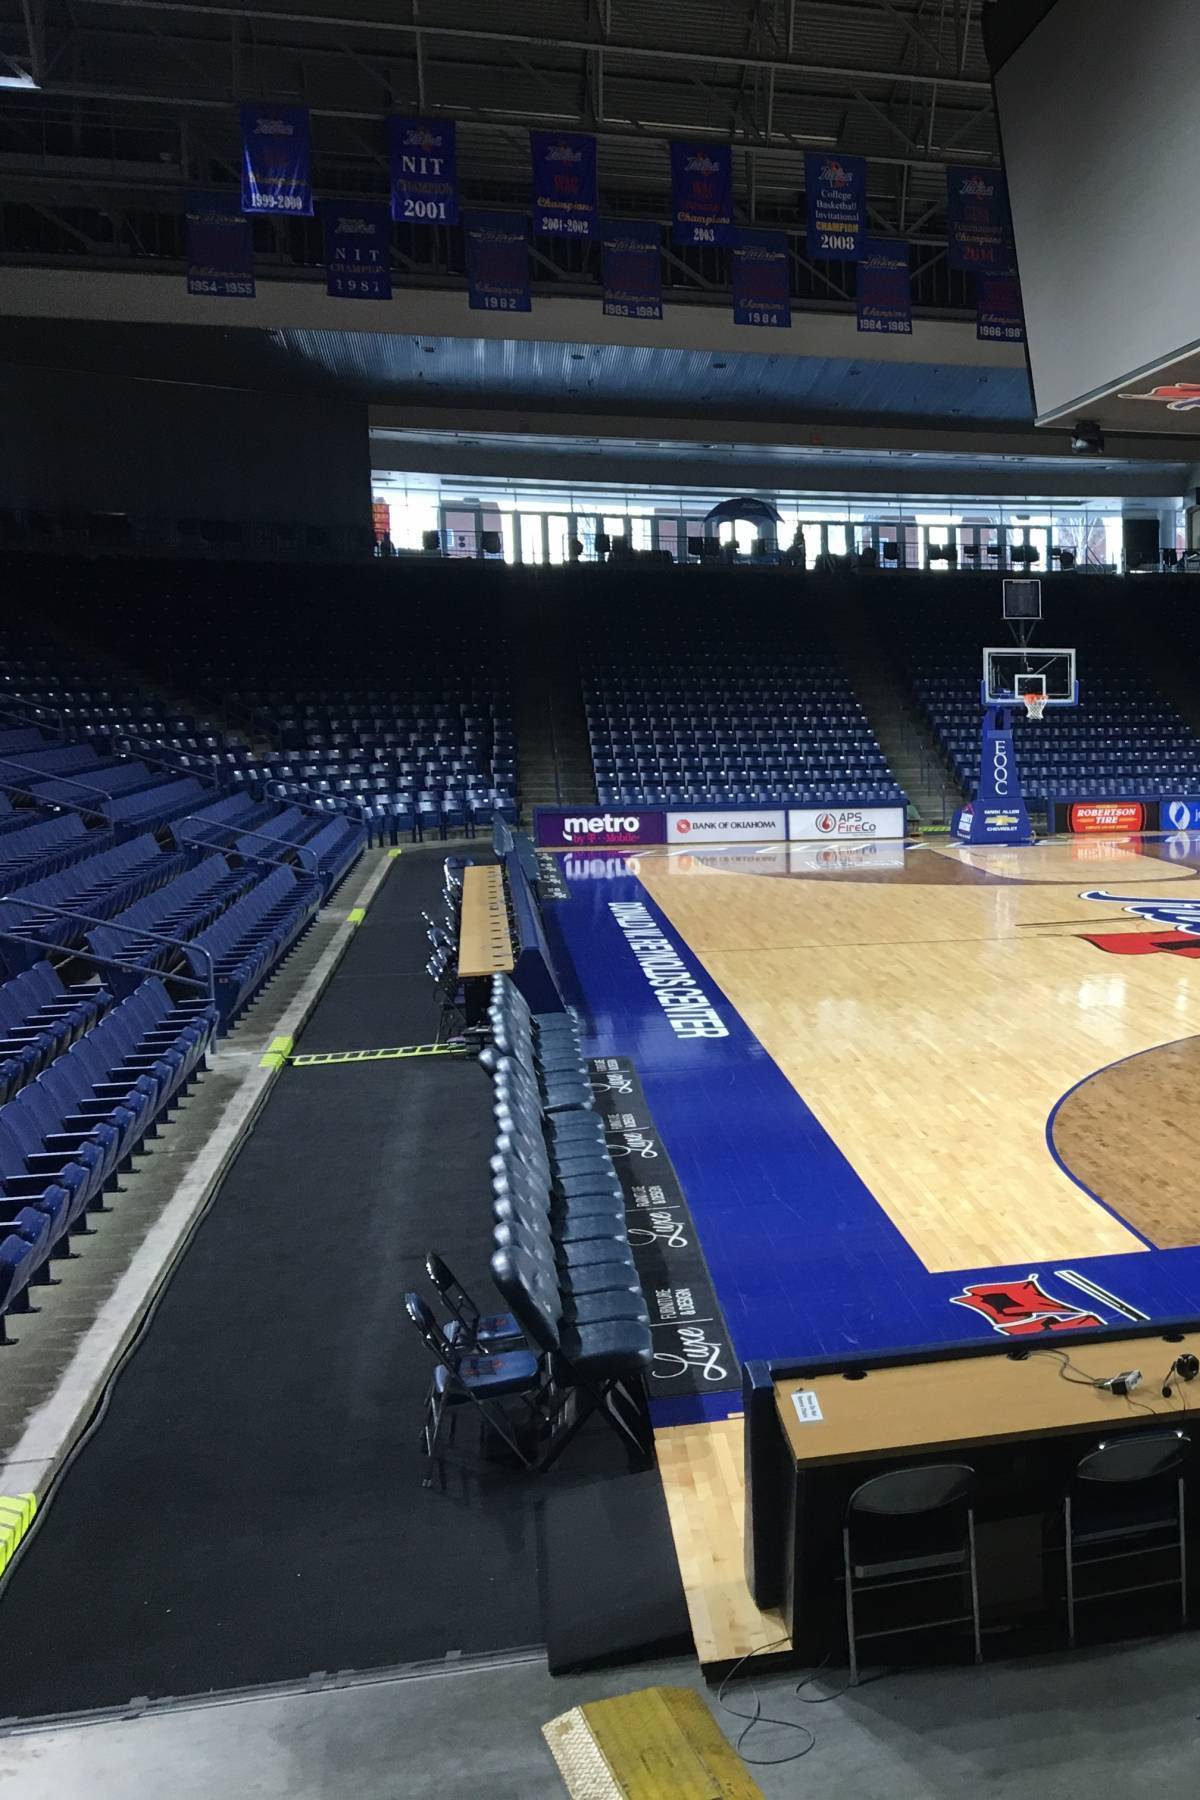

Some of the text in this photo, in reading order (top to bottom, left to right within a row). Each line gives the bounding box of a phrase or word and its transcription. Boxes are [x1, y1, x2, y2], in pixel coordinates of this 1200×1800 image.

[401, 155, 443, 176] NIT
[251, 192, 303, 210] 1999-2000
[820, 189, 852, 202] College
[403, 199, 446, 220] 2001
[815, 199, 857, 210] Basketball
[677, 211, 730, 226] Champions
[814, 210, 860, 222] Invitational
[540, 216, 587, 235] 2001-2002
[815, 220, 859, 233] CHAMPION
[820, 234, 855, 251] 2008
[189, 280, 253, 294] 1954-1955
[482, 296, 515, 310] 1982
[747, 311, 777, 325] 1984
[859, 319, 911, 333] 1984-1985
[837, 811, 861, 822] APS
[1077, 808, 1136, 818] ROBERTSON
[1096, 816, 1118, 825] TIRE
[563, 813, 637, 842] metro
[692, 819, 776, 831] BANK OF OKLAHOMA
[611, 902, 656, 928] DONALD
[628, 938, 696, 987] REYNOLDS
[653, 988, 729, 1039] CENTER
[626, 1211, 688, 1249] Luxe
[655, 1288, 678, 1320] FURNITURE
[674, 1288, 696, 1311] DESIGN
[651, 1326, 728, 1382] Luxe
